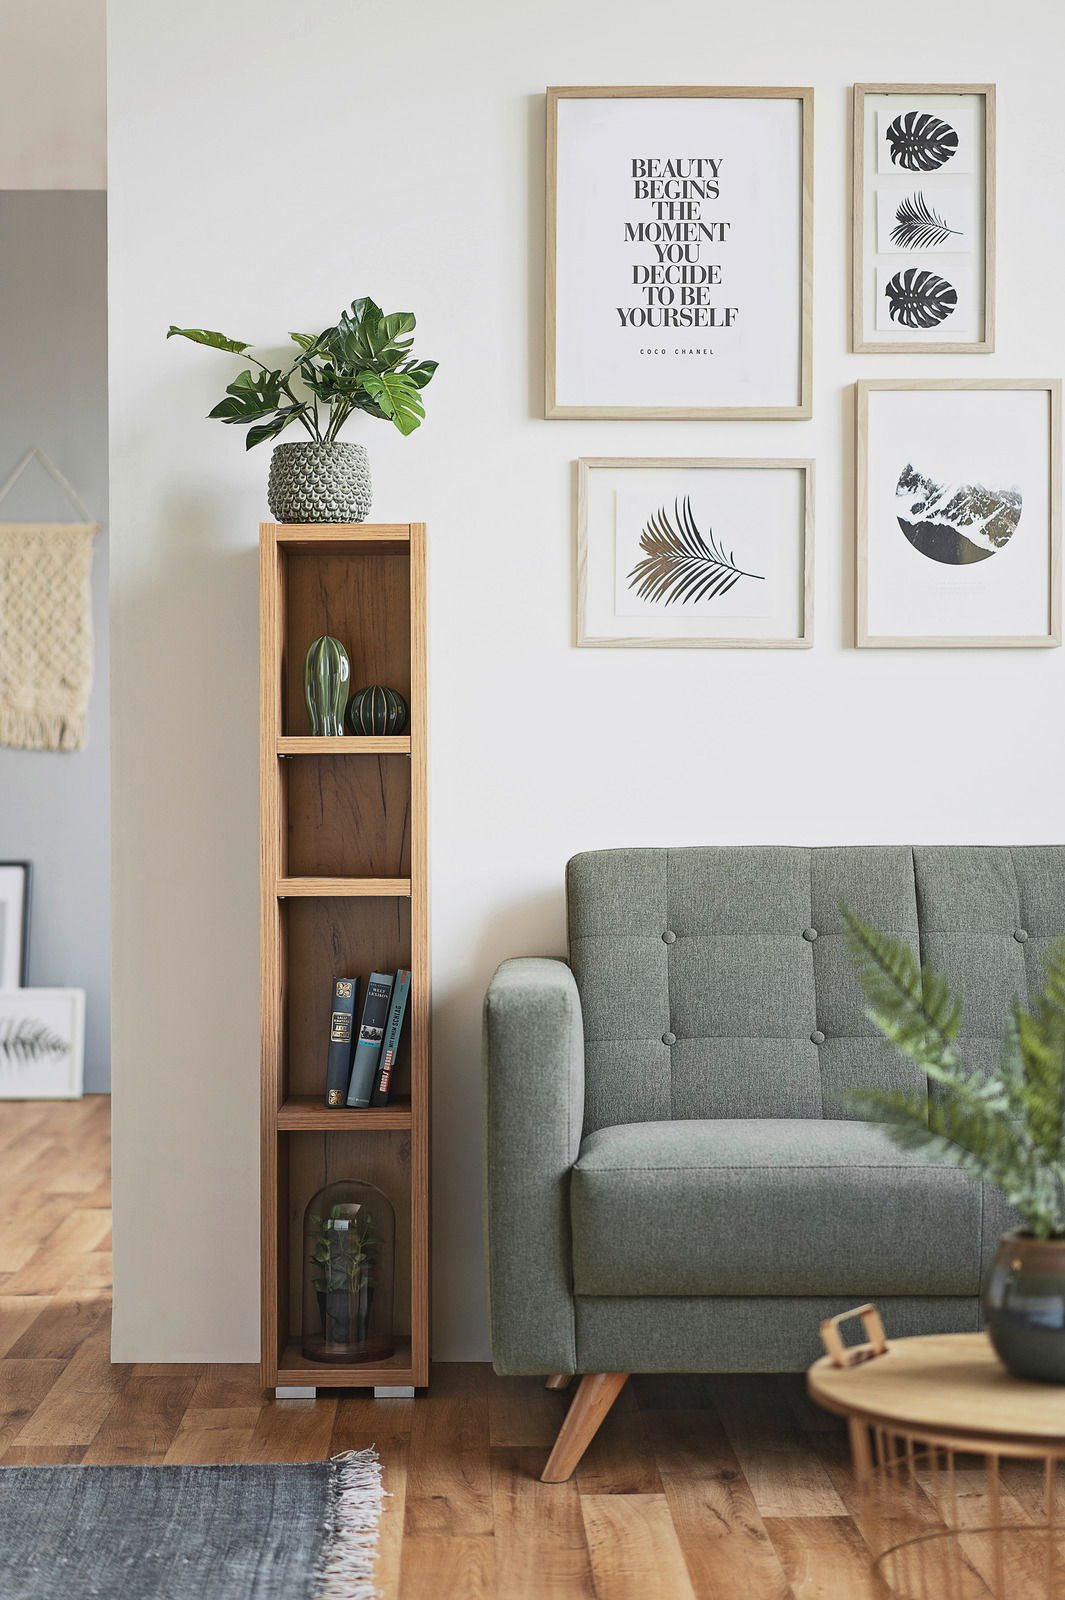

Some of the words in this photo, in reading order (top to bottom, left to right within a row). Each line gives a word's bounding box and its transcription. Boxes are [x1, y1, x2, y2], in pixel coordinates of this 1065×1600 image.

[631, 159, 723, 178] BEAUTY
[634, 180, 719, 199] BEGINS
[652, 201, 701, 220] THE
[624, 222, 730, 242] MOMENT
[653, 244, 700, 263] YOU
[632, 265, 722, 284] DECIDE
[642, 286, 674, 306] TO
[680, 286, 710, 306] BE
[616, 307, 739, 327] YOURSELF
[392, 1005, 402, 1026] SCHLAG
